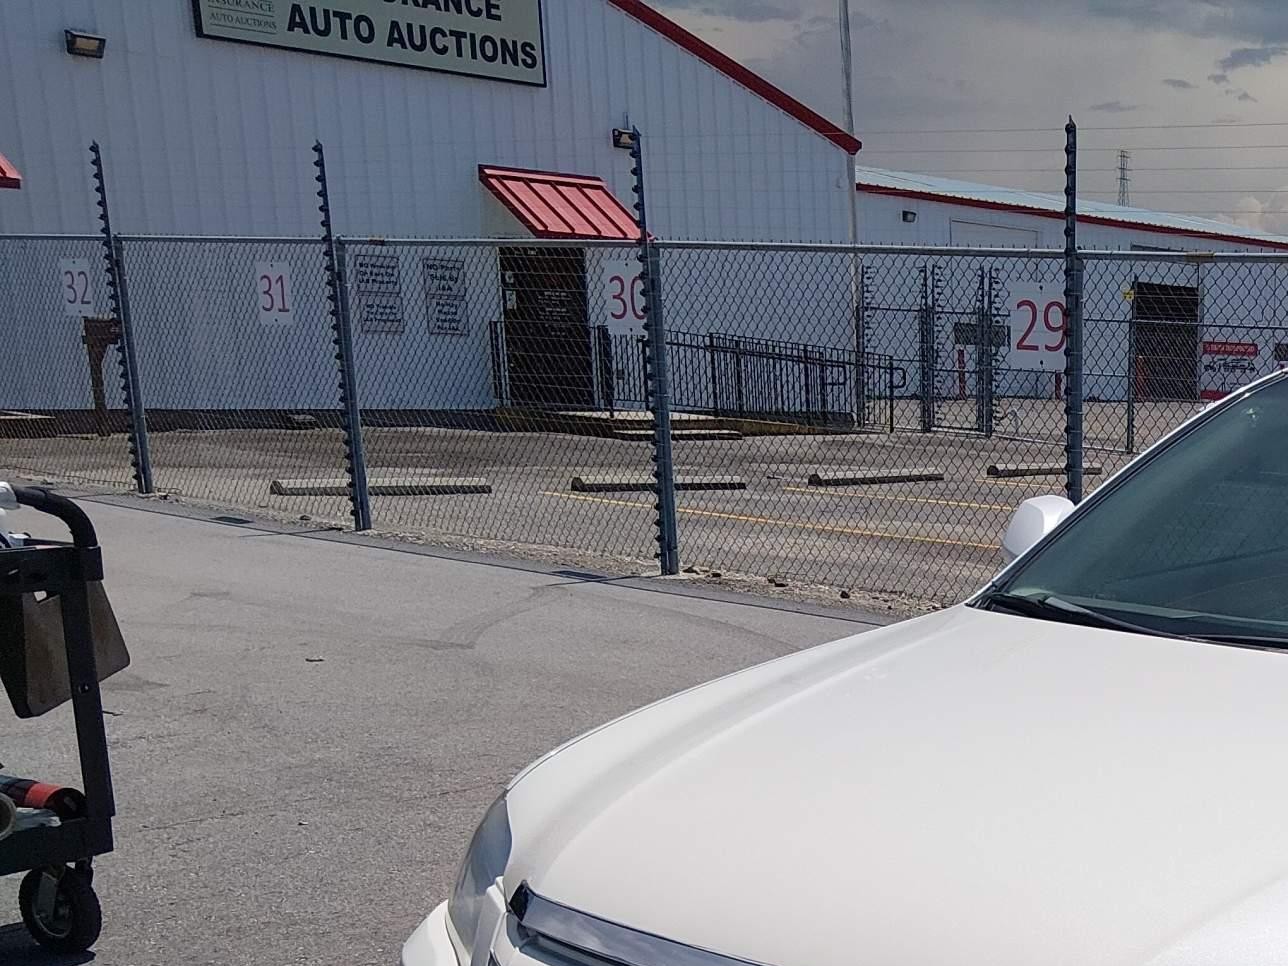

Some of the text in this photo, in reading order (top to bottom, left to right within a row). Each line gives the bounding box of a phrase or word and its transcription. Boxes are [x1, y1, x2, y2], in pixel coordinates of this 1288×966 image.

[287, 3, 537, 69] AUTO AUCTIONS
[64, 270, 92, 305] 32
[259, 274, 290, 313] 31
[609, 275, 647, 320] 30
[1016, 299, 1067, 352] 29
